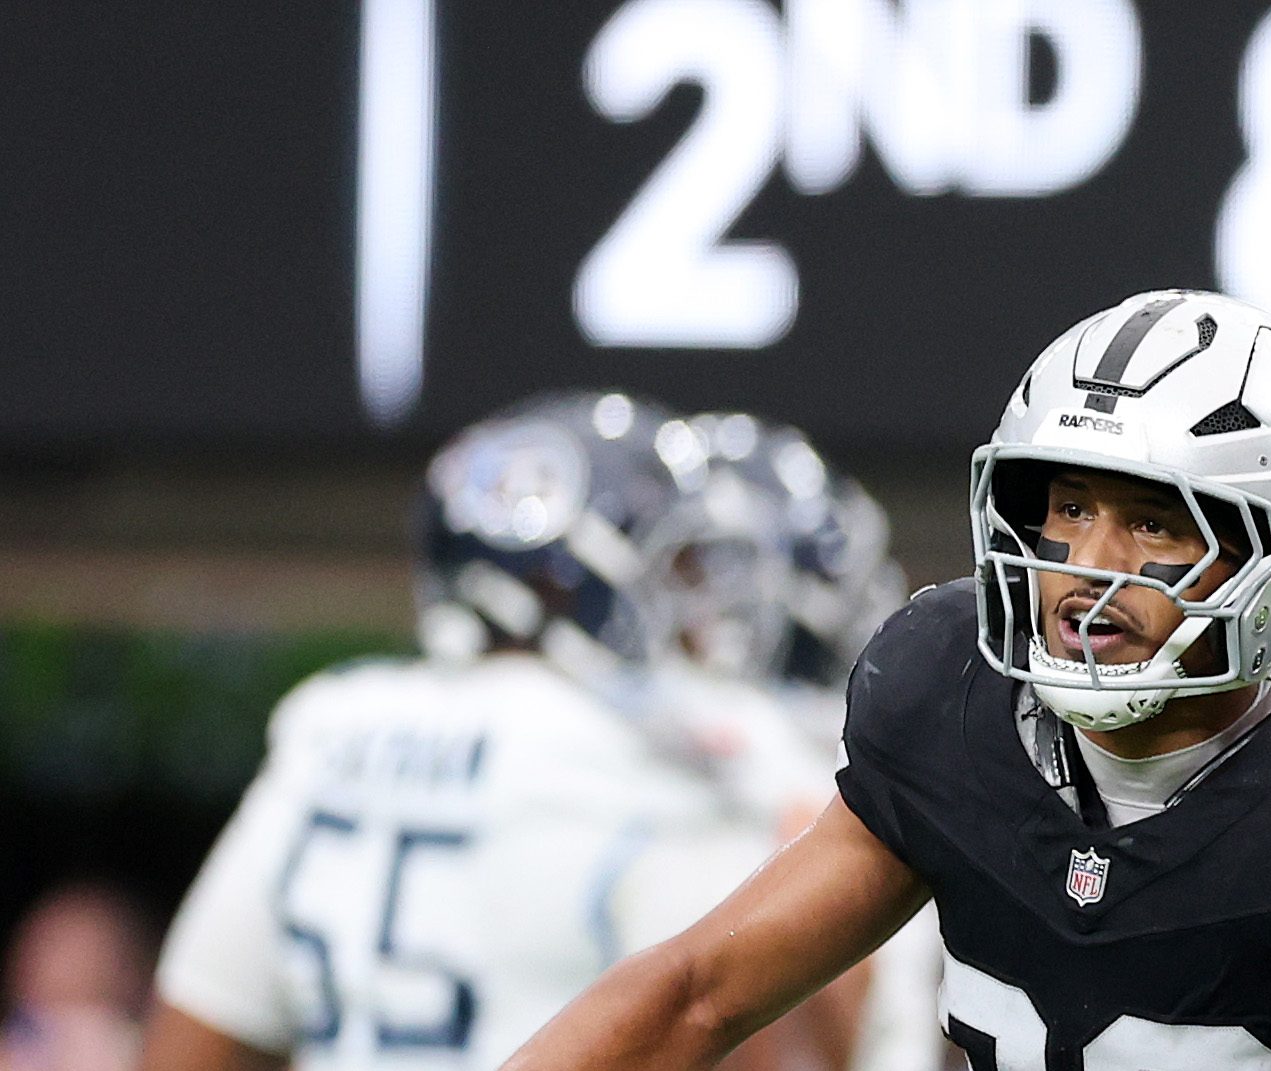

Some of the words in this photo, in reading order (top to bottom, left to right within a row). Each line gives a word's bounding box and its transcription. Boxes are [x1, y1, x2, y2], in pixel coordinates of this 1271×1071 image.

[576, 0, 1143, 348] 2ND
[274, 808, 478, 1055] 55
[1073, 873, 1098, 896] NFL
